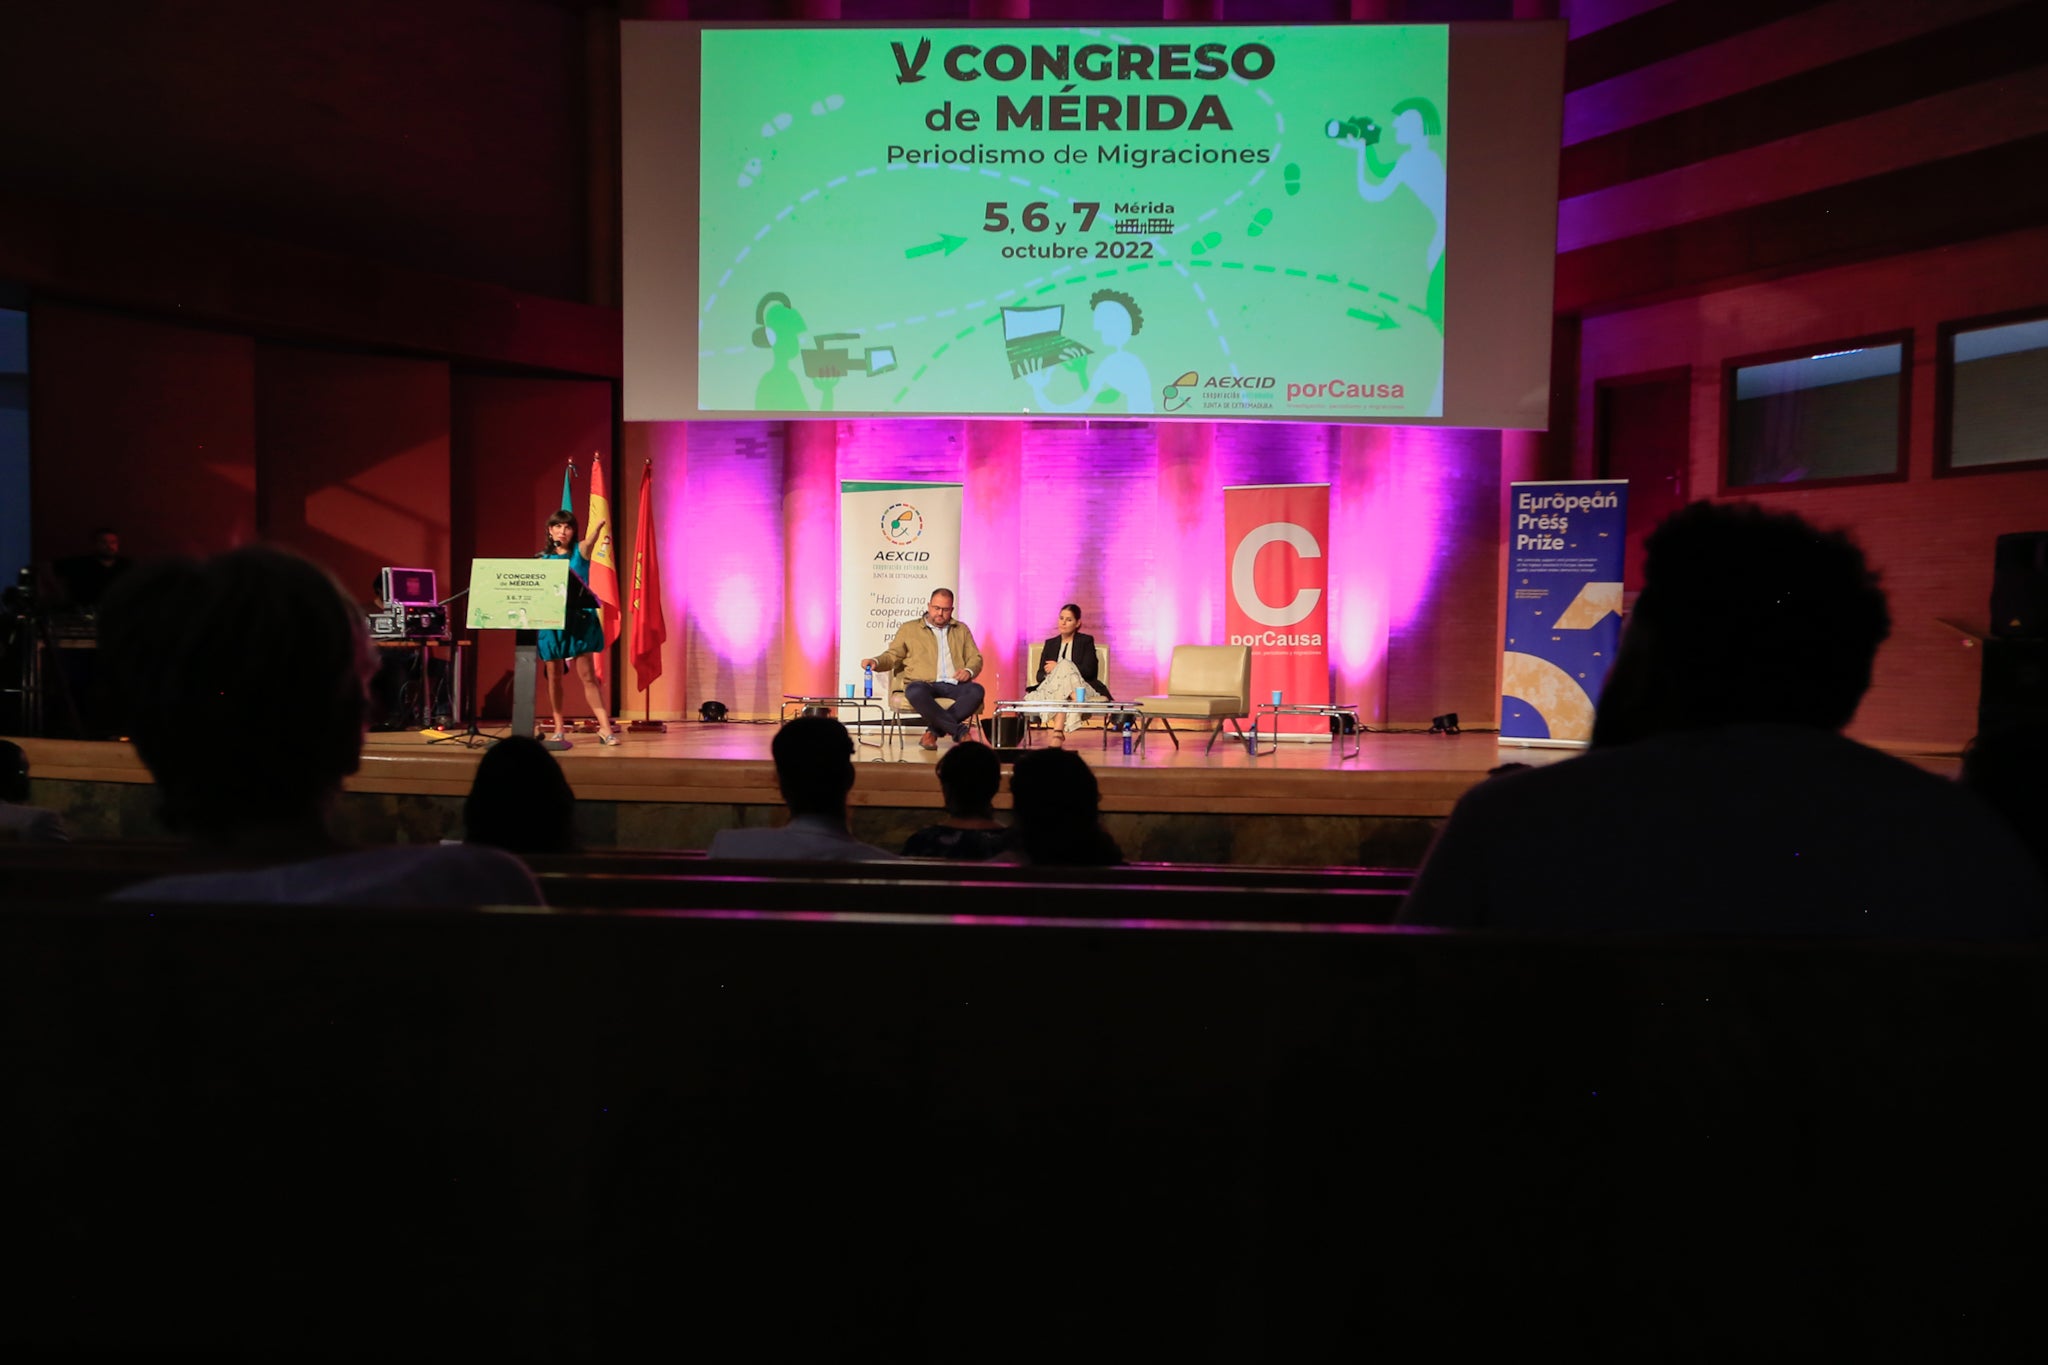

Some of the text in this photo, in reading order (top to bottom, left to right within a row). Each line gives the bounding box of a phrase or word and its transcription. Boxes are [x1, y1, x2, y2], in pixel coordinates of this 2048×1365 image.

[943, 43, 1275, 81] CONGRESO
[925, 84, 1233, 131] de MÉRIDA
[887, 144, 1270, 168] Periodismo de Migraciones
[1021, 201, 1050, 232] 6
[1055, 219, 1067, 235] y
[1072, 201, 1100, 232] 7
[1114, 201, 1175, 215] Mérida
[1001, 241, 1154, 259] octubre 2022
[1204, 376, 1276, 389] AEXCID
[1287, 379, 1404, 401] porCausa
[874, 551, 930, 561] AEXCID
[1231, 522, 1322, 627] C
[870, 607, 927, 618] cooperació
[1231, 631, 1321, 646] porCausa
